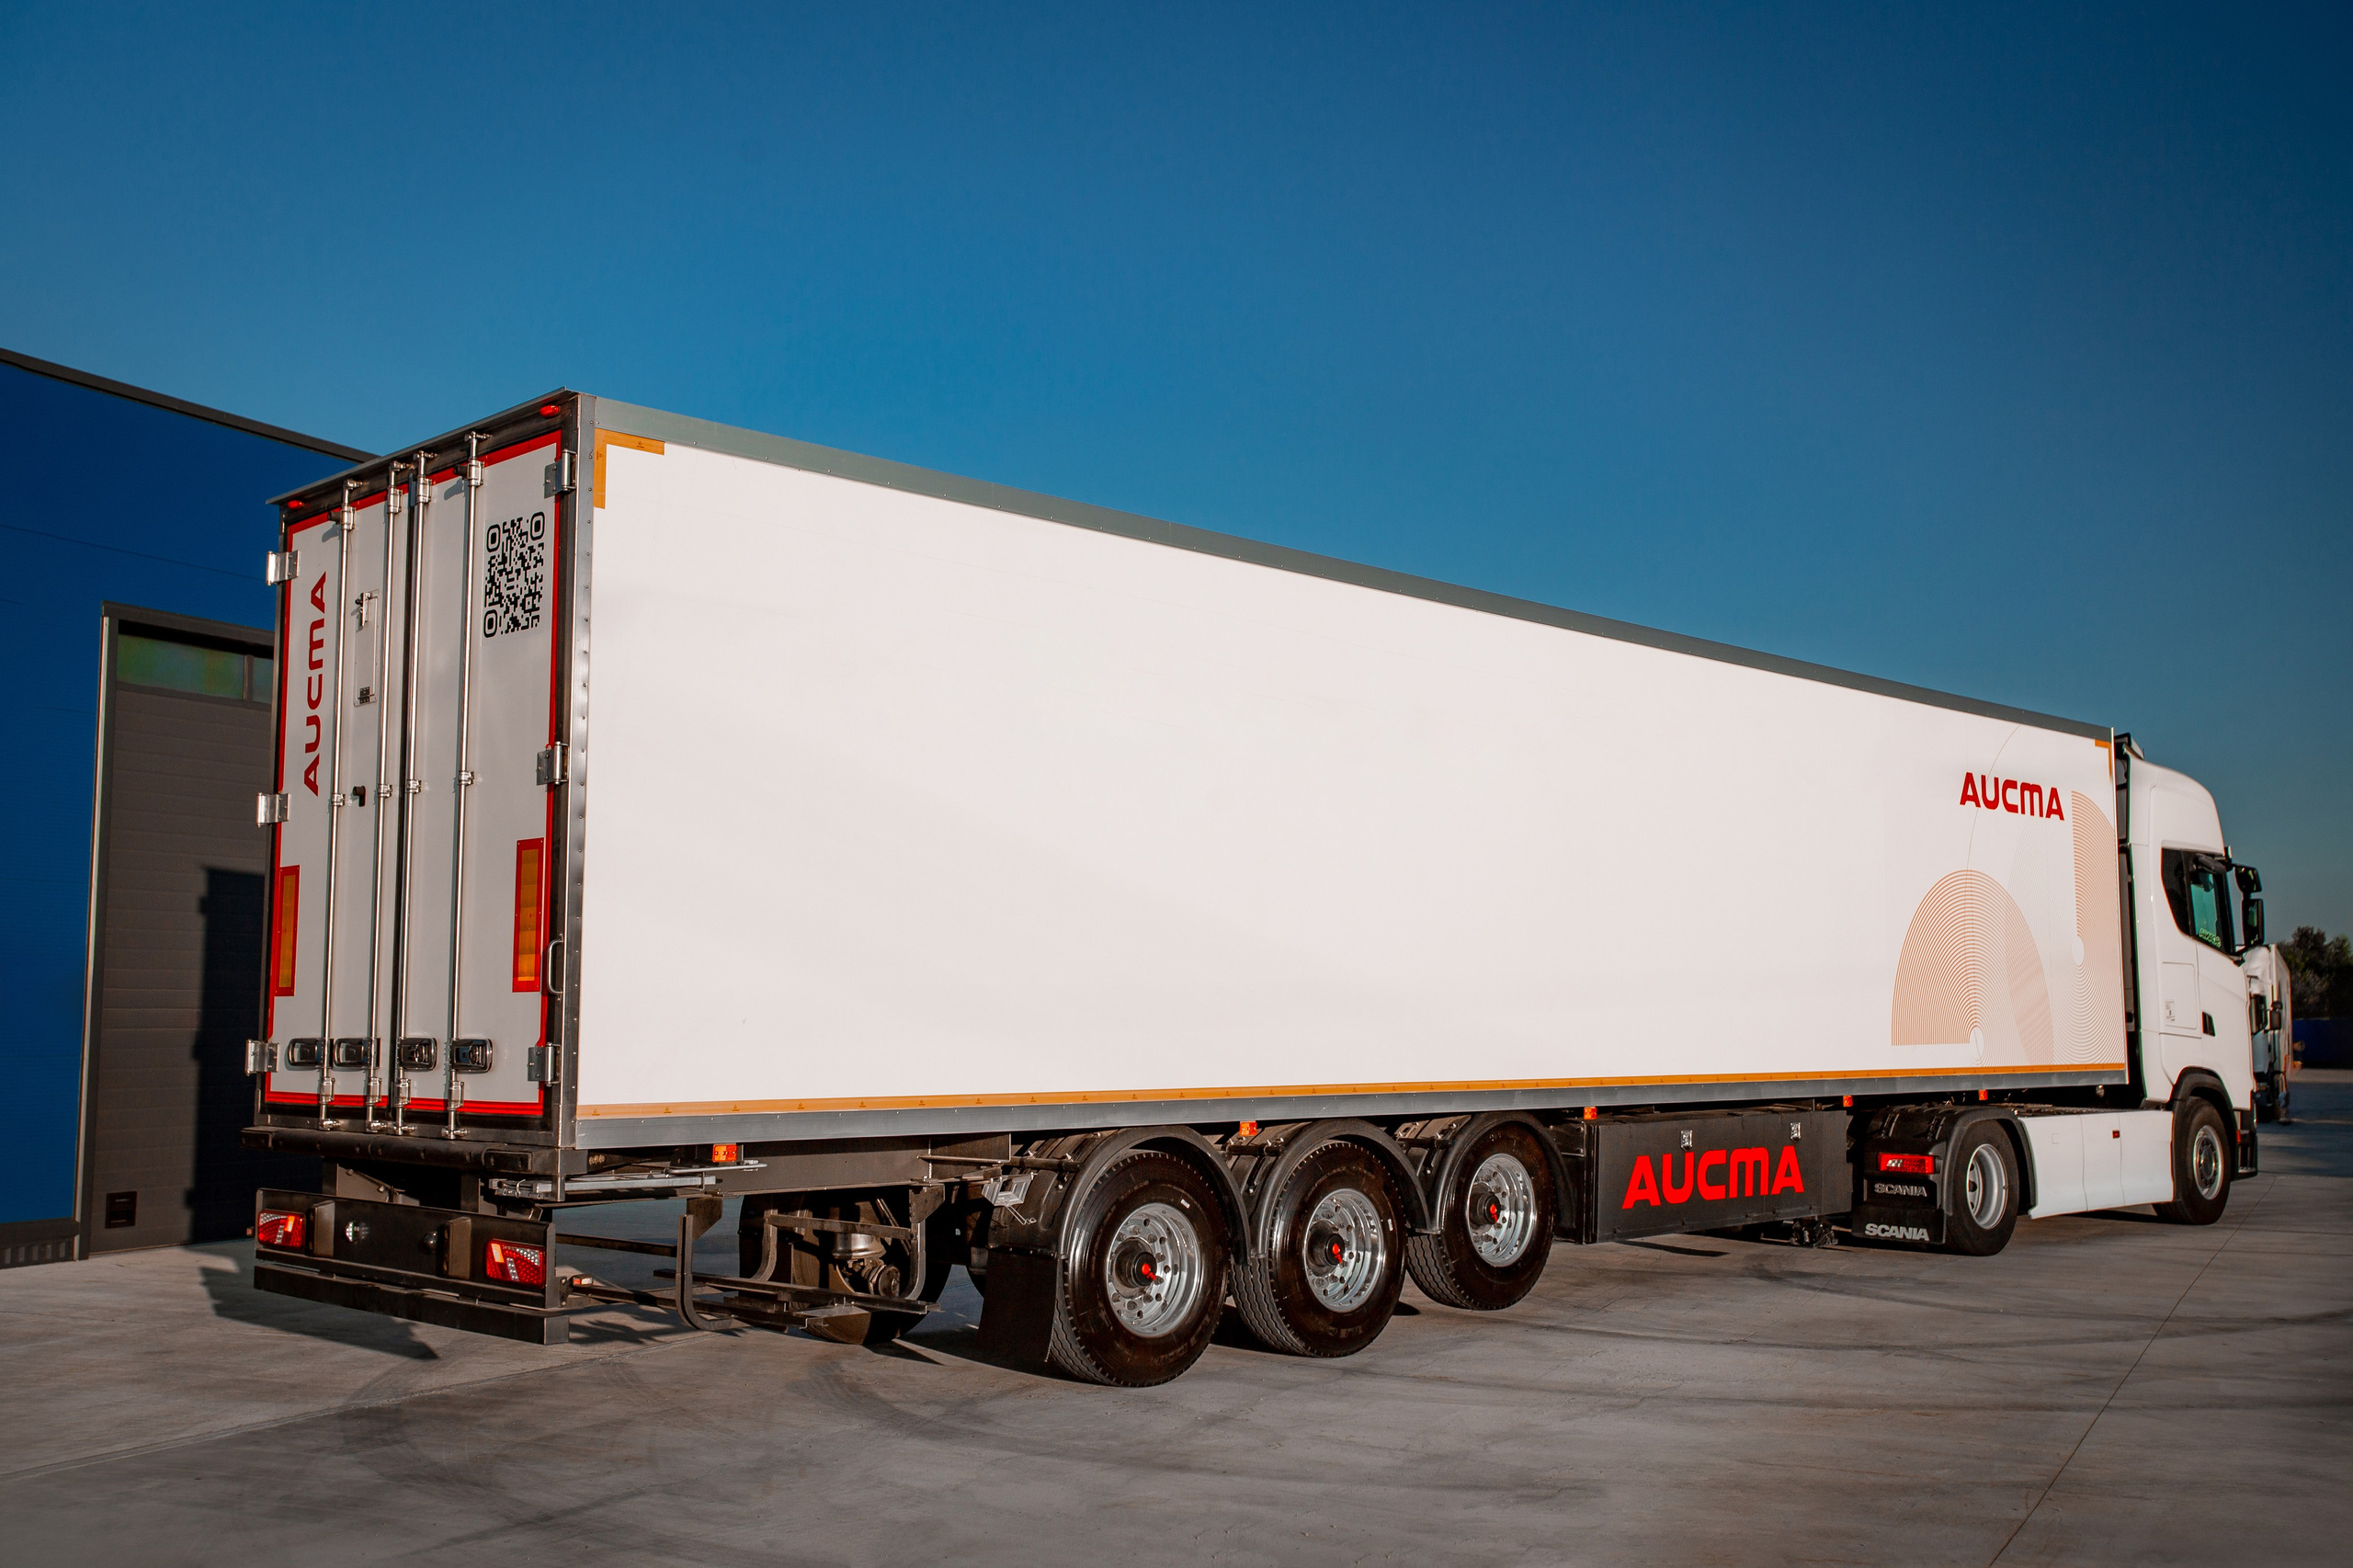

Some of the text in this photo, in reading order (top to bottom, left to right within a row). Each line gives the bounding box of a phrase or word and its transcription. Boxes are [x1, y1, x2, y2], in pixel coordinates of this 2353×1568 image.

[303, 572, 327, 797] AUCMA
[1959, 771, 2065, 822] AUCMA
[1621, 1144, 1805, 1210] AUCMA
[1873, 1182, 1928, 1198] SCANIA
[1864, 1222, 1930, 1242] SCANIA
